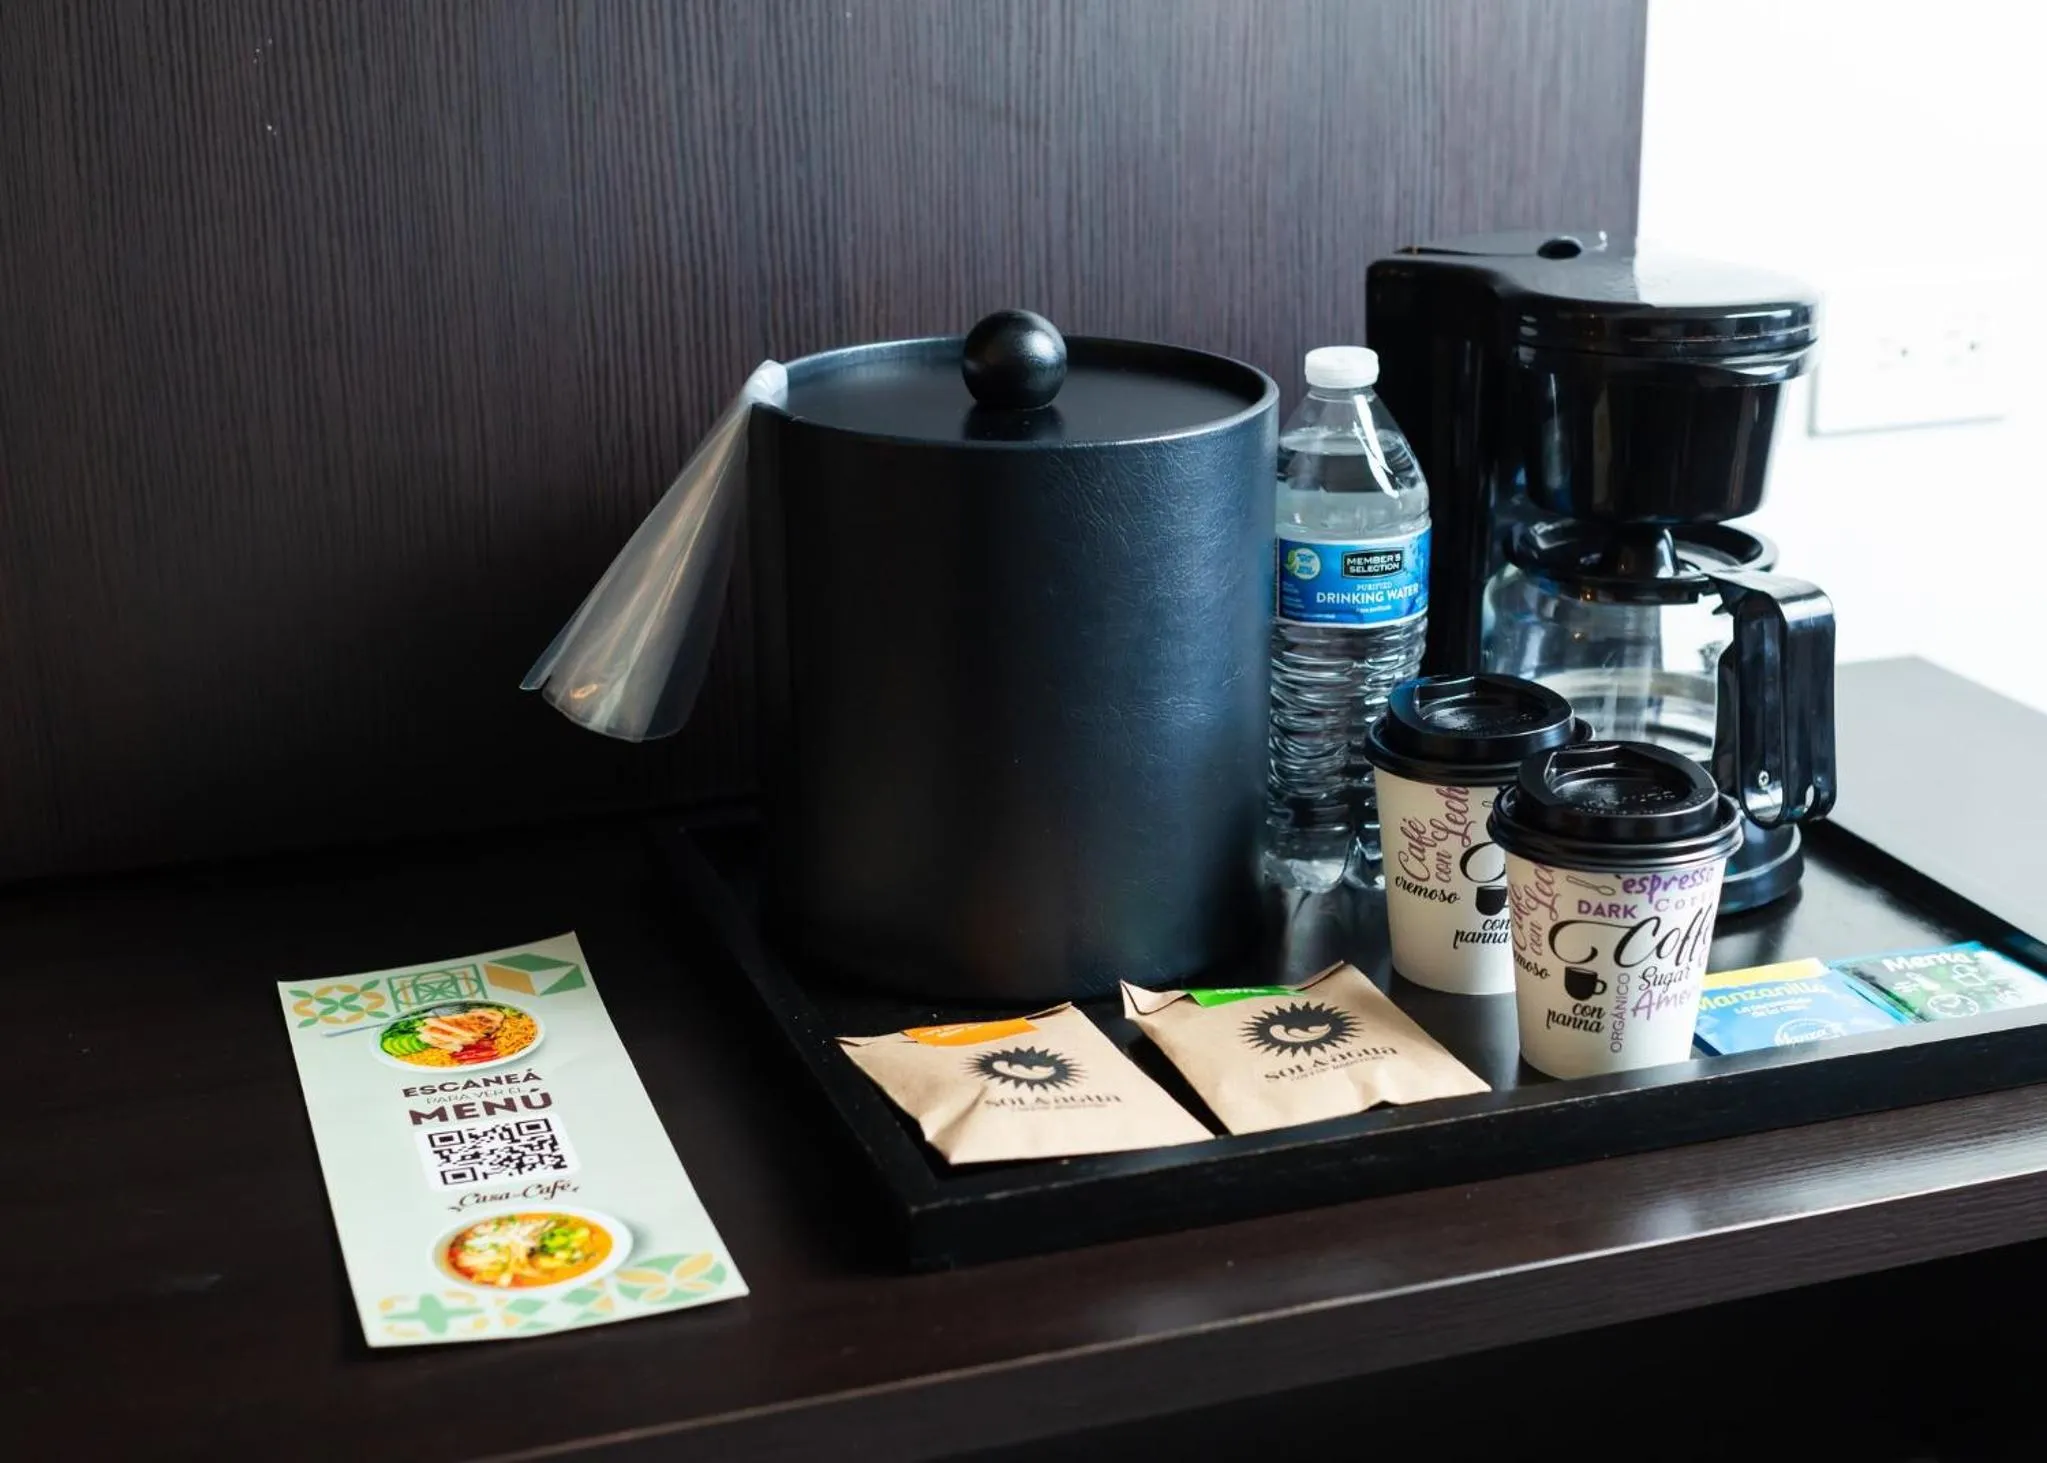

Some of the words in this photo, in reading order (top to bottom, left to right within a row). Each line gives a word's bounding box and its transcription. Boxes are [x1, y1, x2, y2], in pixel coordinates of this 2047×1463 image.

[1346, 552, 1401, 565] MEMBER'S
[1349, 562, 1400, 573] SELECTION
[1316, 592, 1385, 604] DRINKING
[1387, 583, 1419, 600] WATER
[1430, 786, 1477, 848] Lech
[1398, 817, 1437, 882] Café
[1435, 851, 1453, 883] con
[1395, 874, 1461, 904] cremoso
[1578, 899, 1638, 919] DARK
[1453, 928, 1509, 949] panna
[1482, 918, 1511, 932] con
[1638, 965, 1691, 993] Sugar
[1547, 1007, 1605, 1034] panna
[1572, 1002, 1606, 1021] con
[402, 1068, 542, 1098] ESCANEÁ
[409, 1088, 553, 1125] MENÚ
